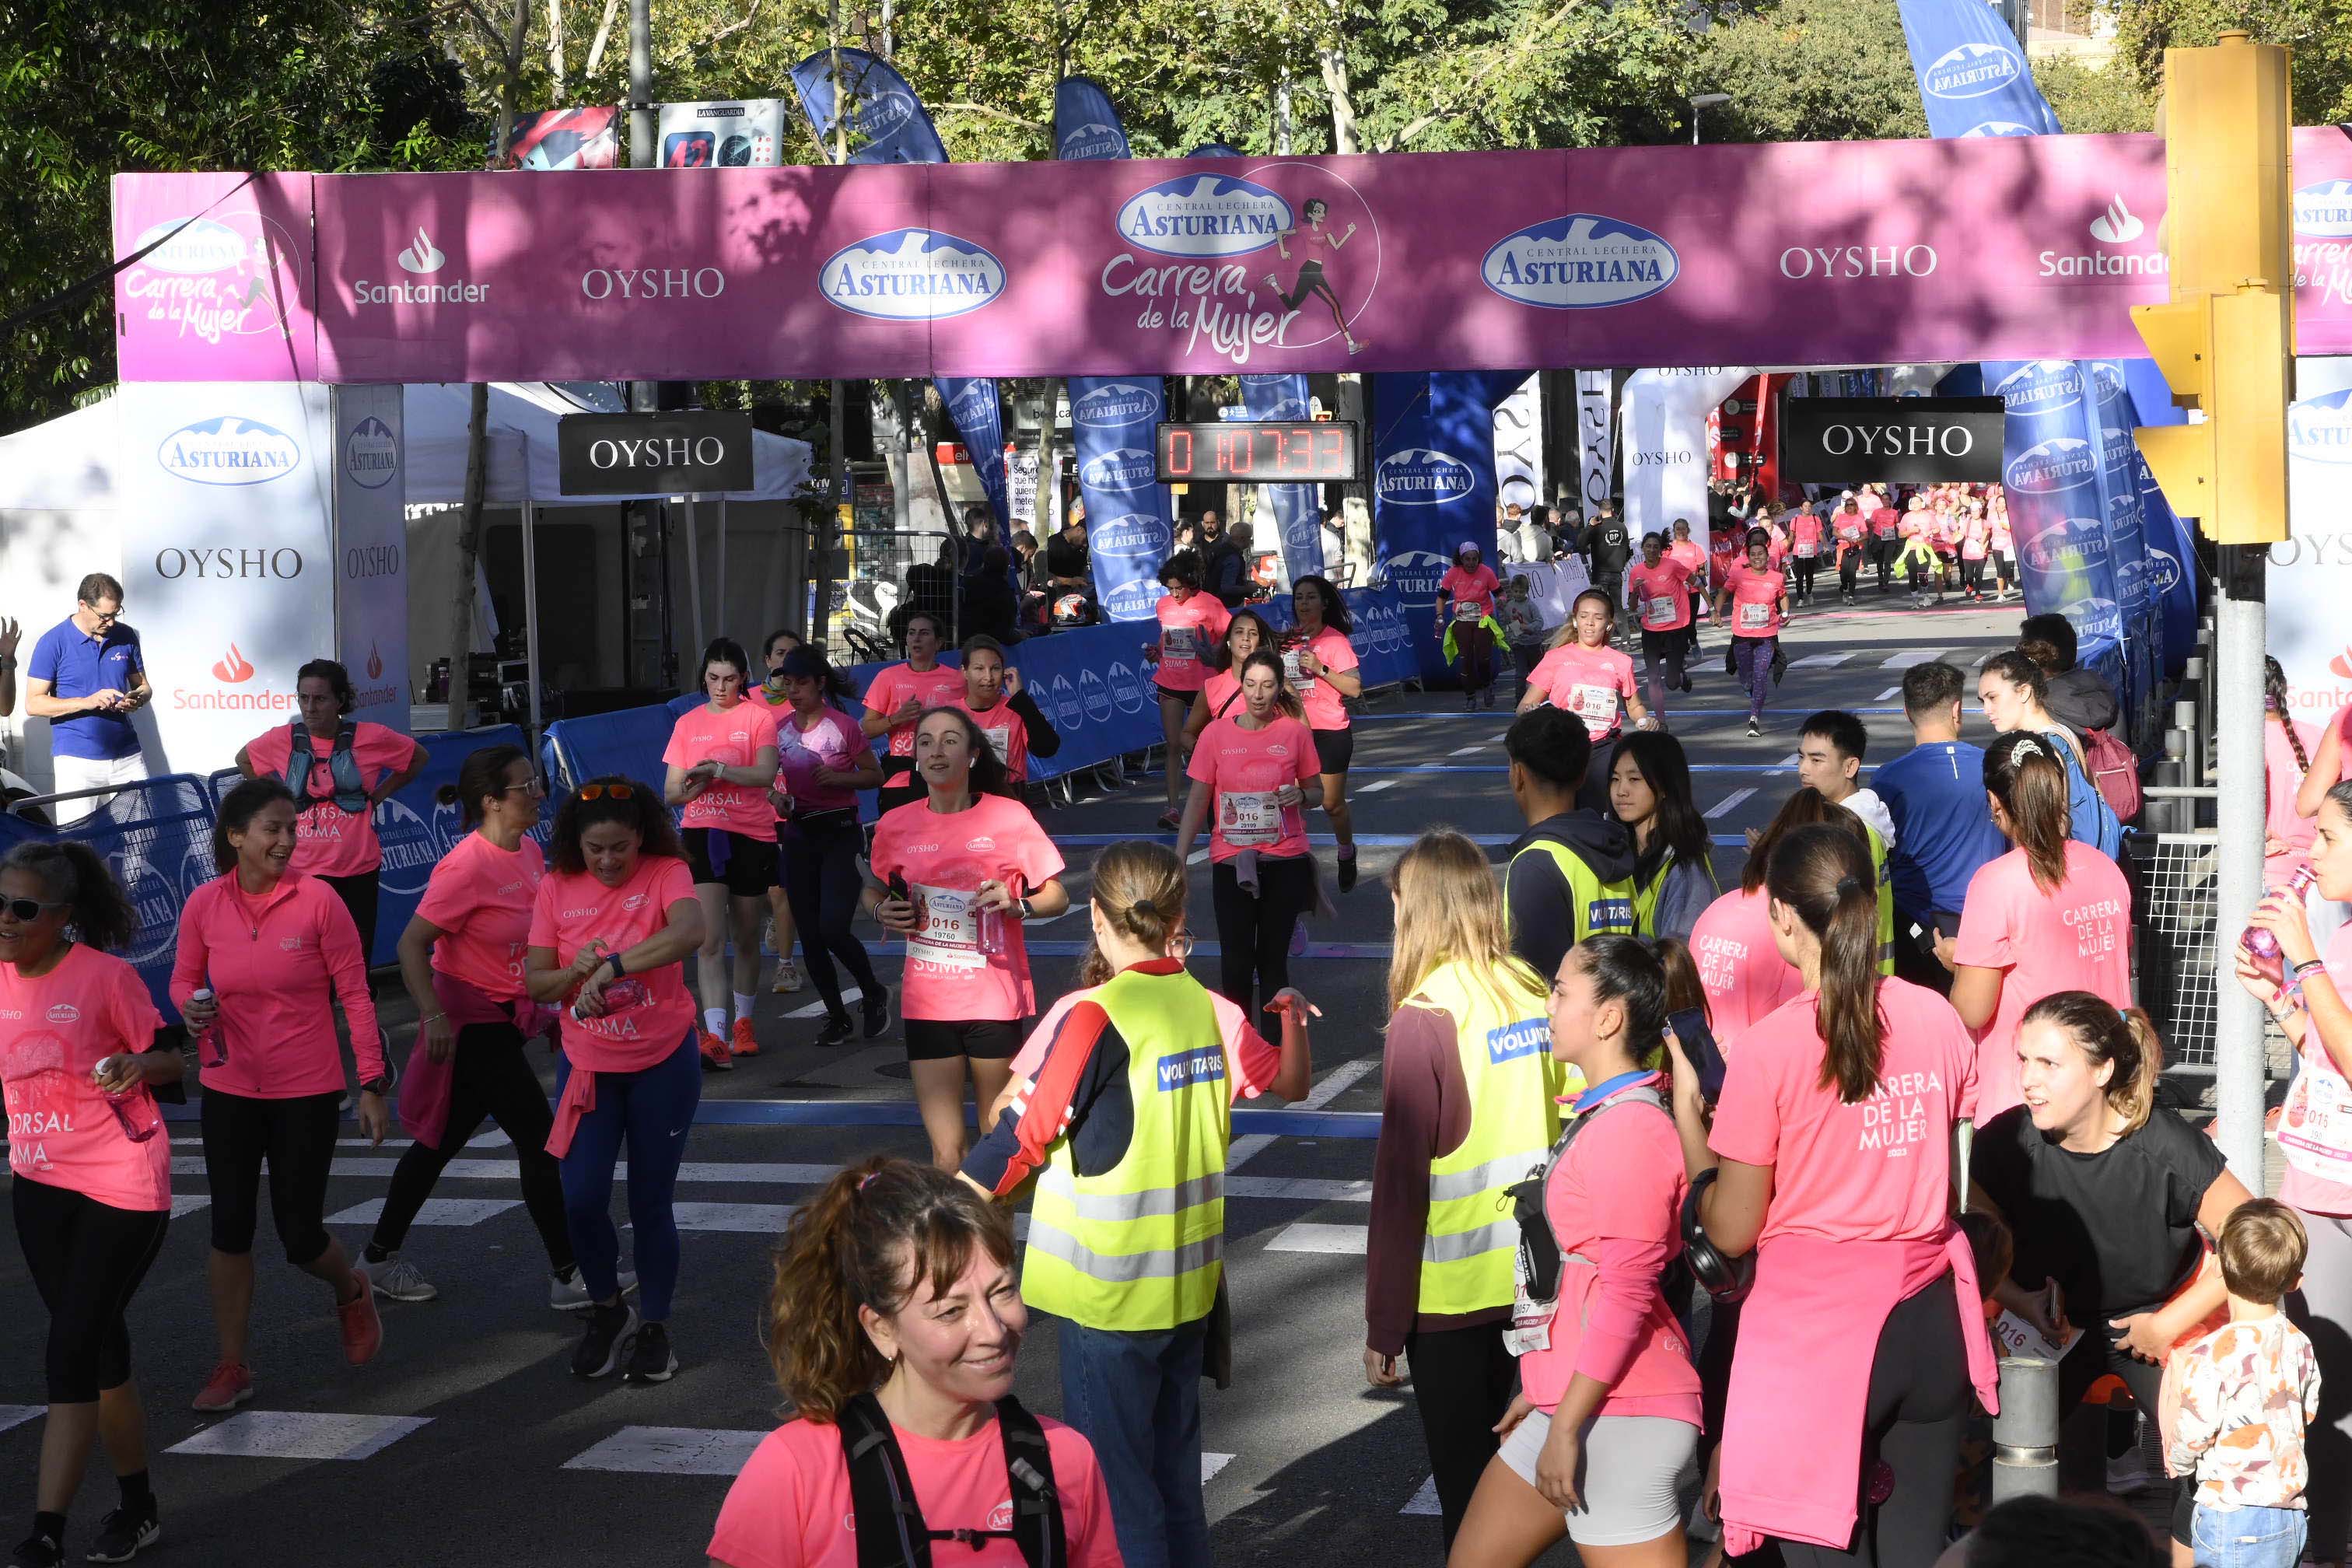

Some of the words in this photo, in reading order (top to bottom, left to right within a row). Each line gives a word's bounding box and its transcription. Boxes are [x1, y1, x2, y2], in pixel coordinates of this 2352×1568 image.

[1157, 201, 1213, 212] CENTRAL
[1217, 201, 1275, 210] LECHERA
[1130, 205, 1279, 236] ASTURIANA
[1527, 246, 1588, 257] CENTRAL
[1594, 245, 1657, 256] LECHERA
[1780, 244, 1937, 279] OYSHO
[861, 259, 922, 270] CENTRAL
[926, 258, 985, 268] LECHERA
[1101, 254, 1247, 296] Carrera
[1496, 250, 1664, 285] ASTURIANA
[2039, 251, 2169, 277] Santand
[2312, 264, 2325, 287] la
[124, 268, 218, 299] Carrera
[581, 267, 725, 299] OYSHO
[833, 262, 992, 297] ASTURIANA
[355, 281, 490, 304] Santander
[148, 300, 165, 320] de
[169, 299, 181, 320] la
[178, 296, 252, 345] Mujer
[1137, 299, 1164, 329] de
[1170, 299, 1189, 329] la
[1185, 290, 1302, 364] Mujer
[590, 436, 724, 468] OYSHO
[1168, 431, 1193, 474] 0
[1217, 430, 1344, 474] 1:07:33
[1822, 425, 1973, 457] OYSHO
[169, 442, 290, 468] ASTURIANA
[349, 444, 394, 471] ASTURIANA
[1633, 450, 1691, 466] OYSHO
[1014, 477, 1027, 485] que
[1380, 471, 1467, 493] ASTURIANA
[1608, 532, 1619, 541] BP
[156, 548, 302, 579] OYSHO
[347, 544, 398, 579] OYSHO
[1395, 578, 1442, 593] TURIA
[1164, 659, 1188, 667] SUMA
[173, 689, 296, 709] Santander
[1586, 702, 1601, 710] 016
[894, 740, 915, 752] SU
[689, 806, 728, 817] SUMA
[297, 824, 341, 838] SUMA
[380, 839, 436, 872] STURIANA
[907, 843, 939, 853] OYSHO
[498, 880, 523, 895] OYSHO
[563, 908, 597, 919] OYSHO
[933, 900, 963, 909] ASTURIANA
[2063, 899, 2121, 926] CARRERA
[932, 918, 960, 929] 016
[2077, 923, 2094, 940] DE
[2098, 920, 2113, 935] LA
[912, 946, 934, 956] OYSHO
[1699, 935, 1748, 959] CARRERA
[2077, 934, 2116, 958] MUJER
[1702, 954, 1719, 968] DE
[1722, 957, 1734, 972] LA
[1700, 971, 1734, 992] MUJER
[1160, 1055, 1223, 1083] VOLUNTARIS
[1864, 1101, 1892, 1127] DE
[1899, 1096, 1925, 1120] LA
[1858, 1118, 1927, 1151] MUJER
[1514, 1283, 1528, 1299] 01
[1997, 1321, 2027, 1347] 016
